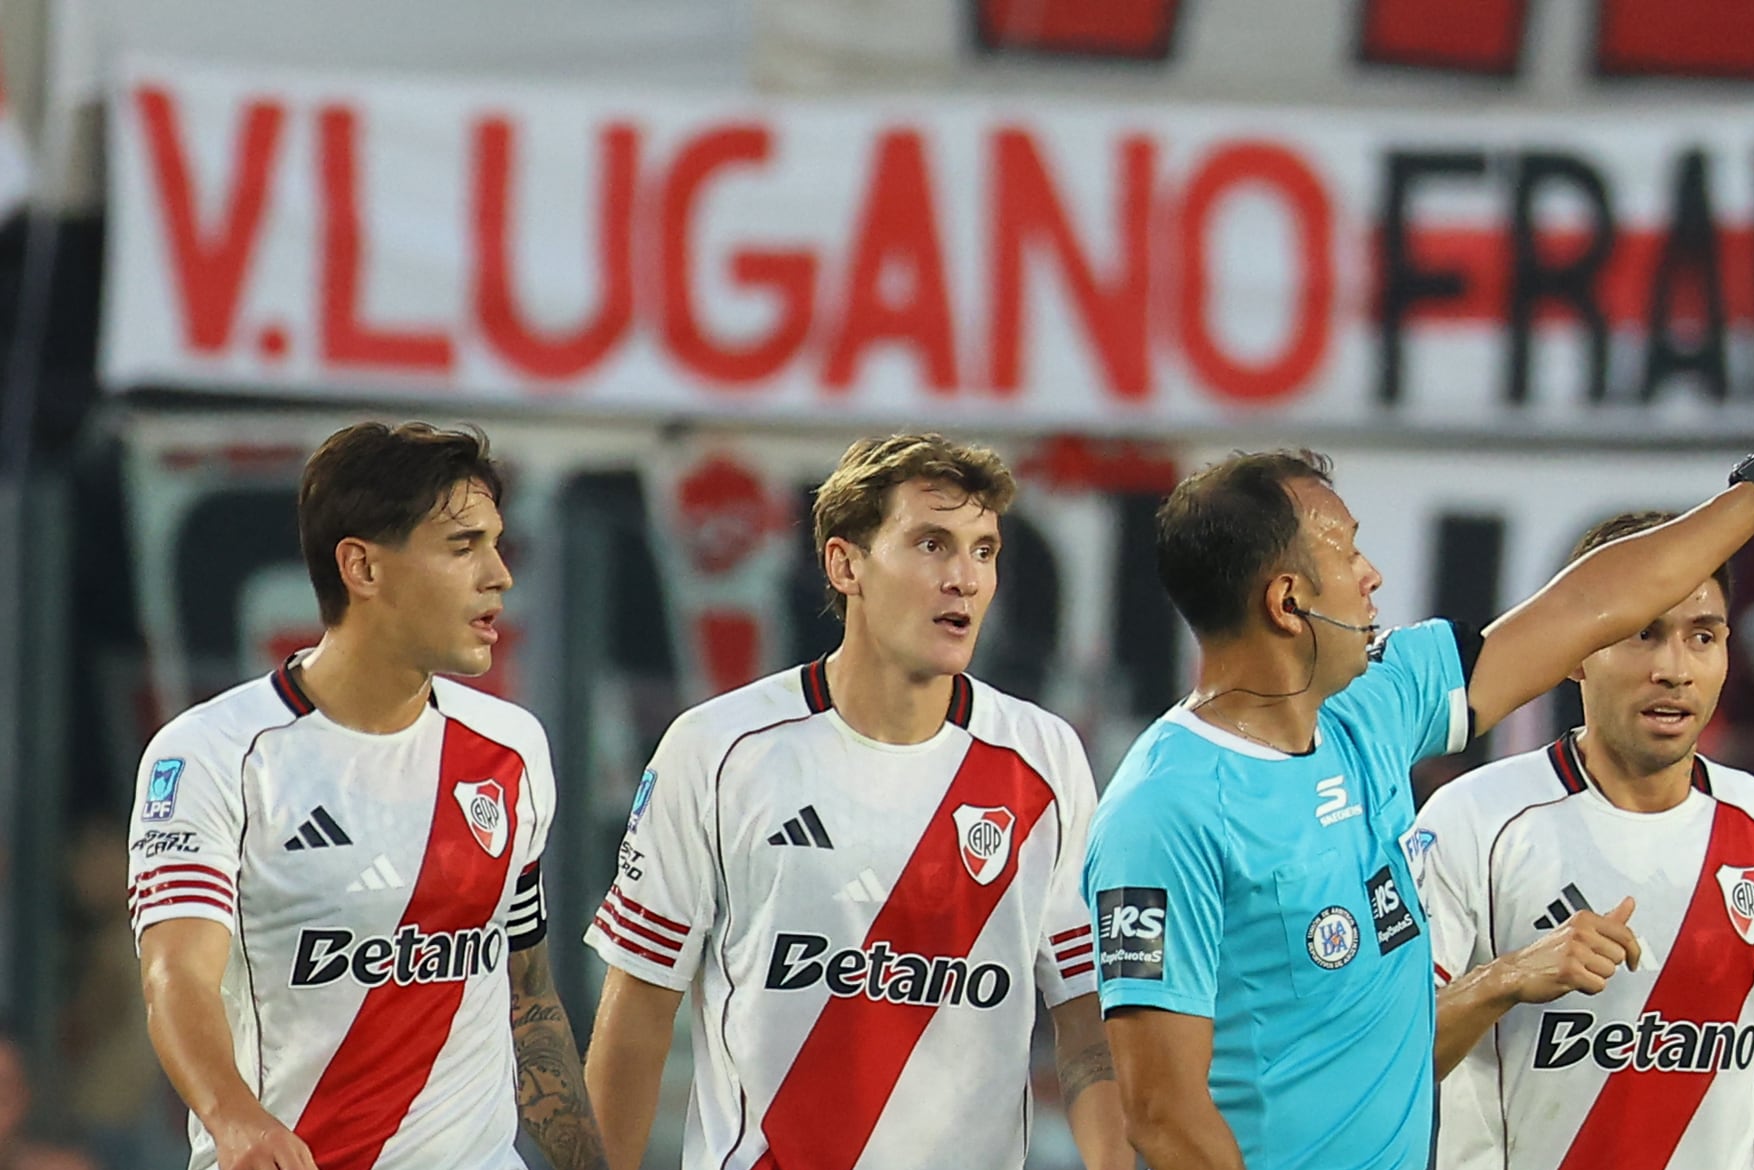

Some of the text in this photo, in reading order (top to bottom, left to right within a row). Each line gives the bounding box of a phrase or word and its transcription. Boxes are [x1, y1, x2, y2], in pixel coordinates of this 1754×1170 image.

[142, 800, 172, 819] LPF
[1110, 905, 1165, 939] RS
[291, 927, 501, 987] Betano
[764, 932, 1012, 1010] Betano
